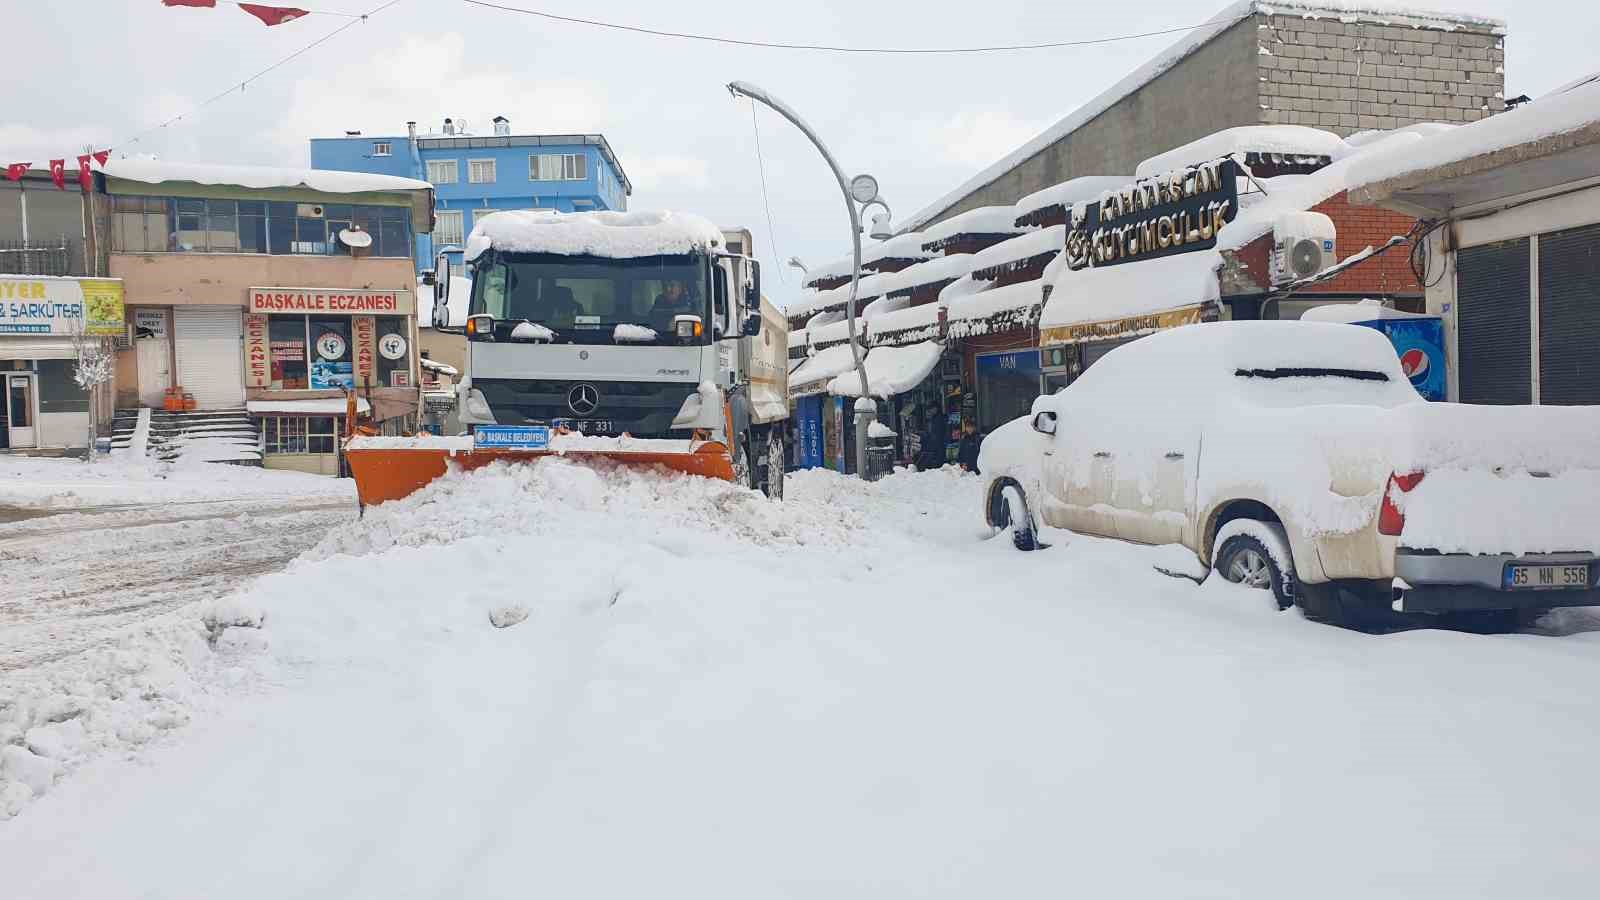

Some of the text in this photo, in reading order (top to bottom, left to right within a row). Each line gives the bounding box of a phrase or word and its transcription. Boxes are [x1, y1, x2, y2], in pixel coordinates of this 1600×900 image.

[1090, 200, 1230, 266] KUYUMCULUK
[10, 300, 83, 322] ŞARKÜTERİ
[255, 293, 397, 311] BAŞKALE ECZANESİ
[596, 420, 612, 432] 331
[1514, 567, 1586, 584] 65 NN 556
